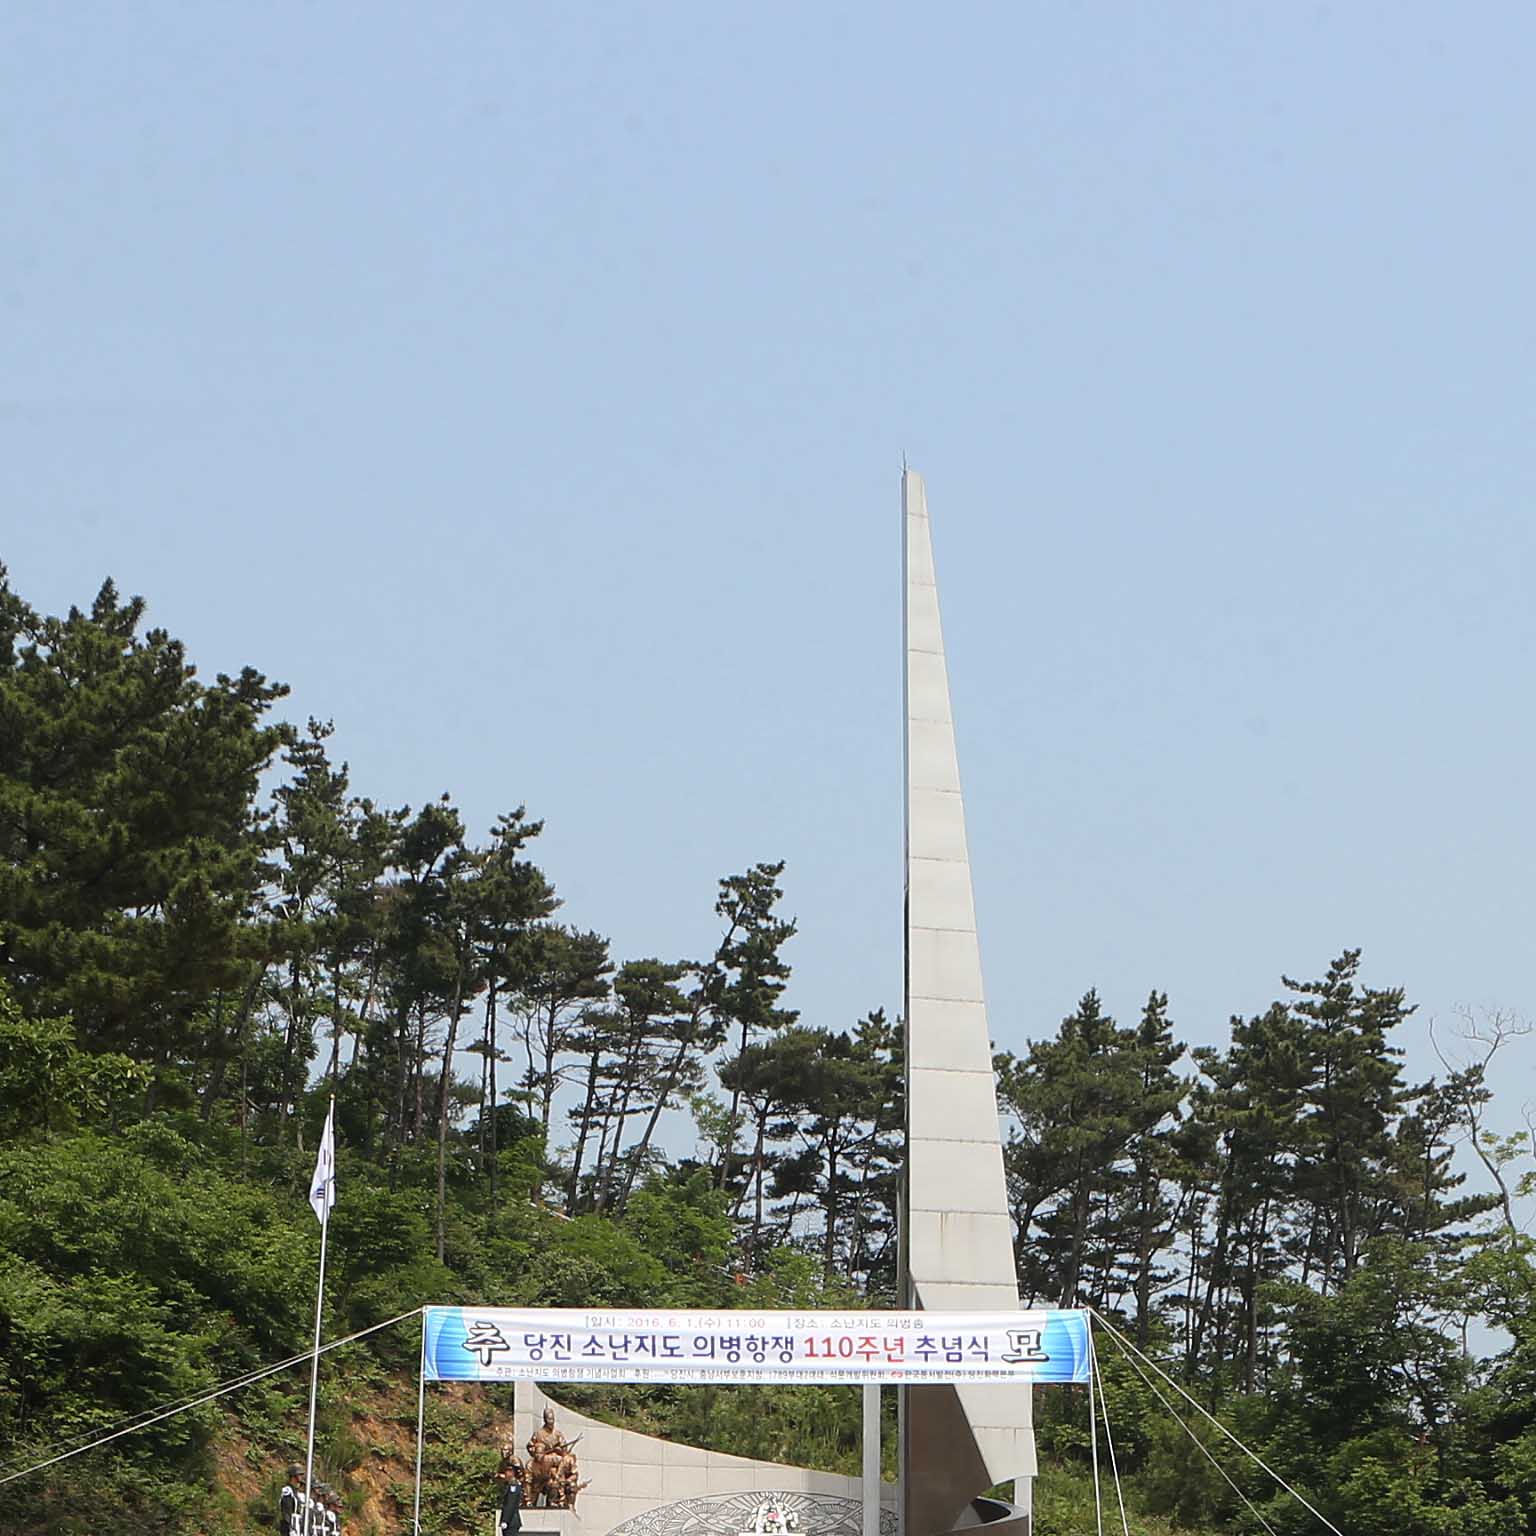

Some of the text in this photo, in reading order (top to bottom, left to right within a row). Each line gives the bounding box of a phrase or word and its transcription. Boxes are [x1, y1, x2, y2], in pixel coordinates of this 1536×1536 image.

[830, 1317, 882, 1329] 소난지도
[462, 1320, 511, 1367] 추
[524, 1333, 990, 1363] 당진 소난지도 의병항쟁 110주년 추념식
[1001, 1329, 1050, 1364] 모
